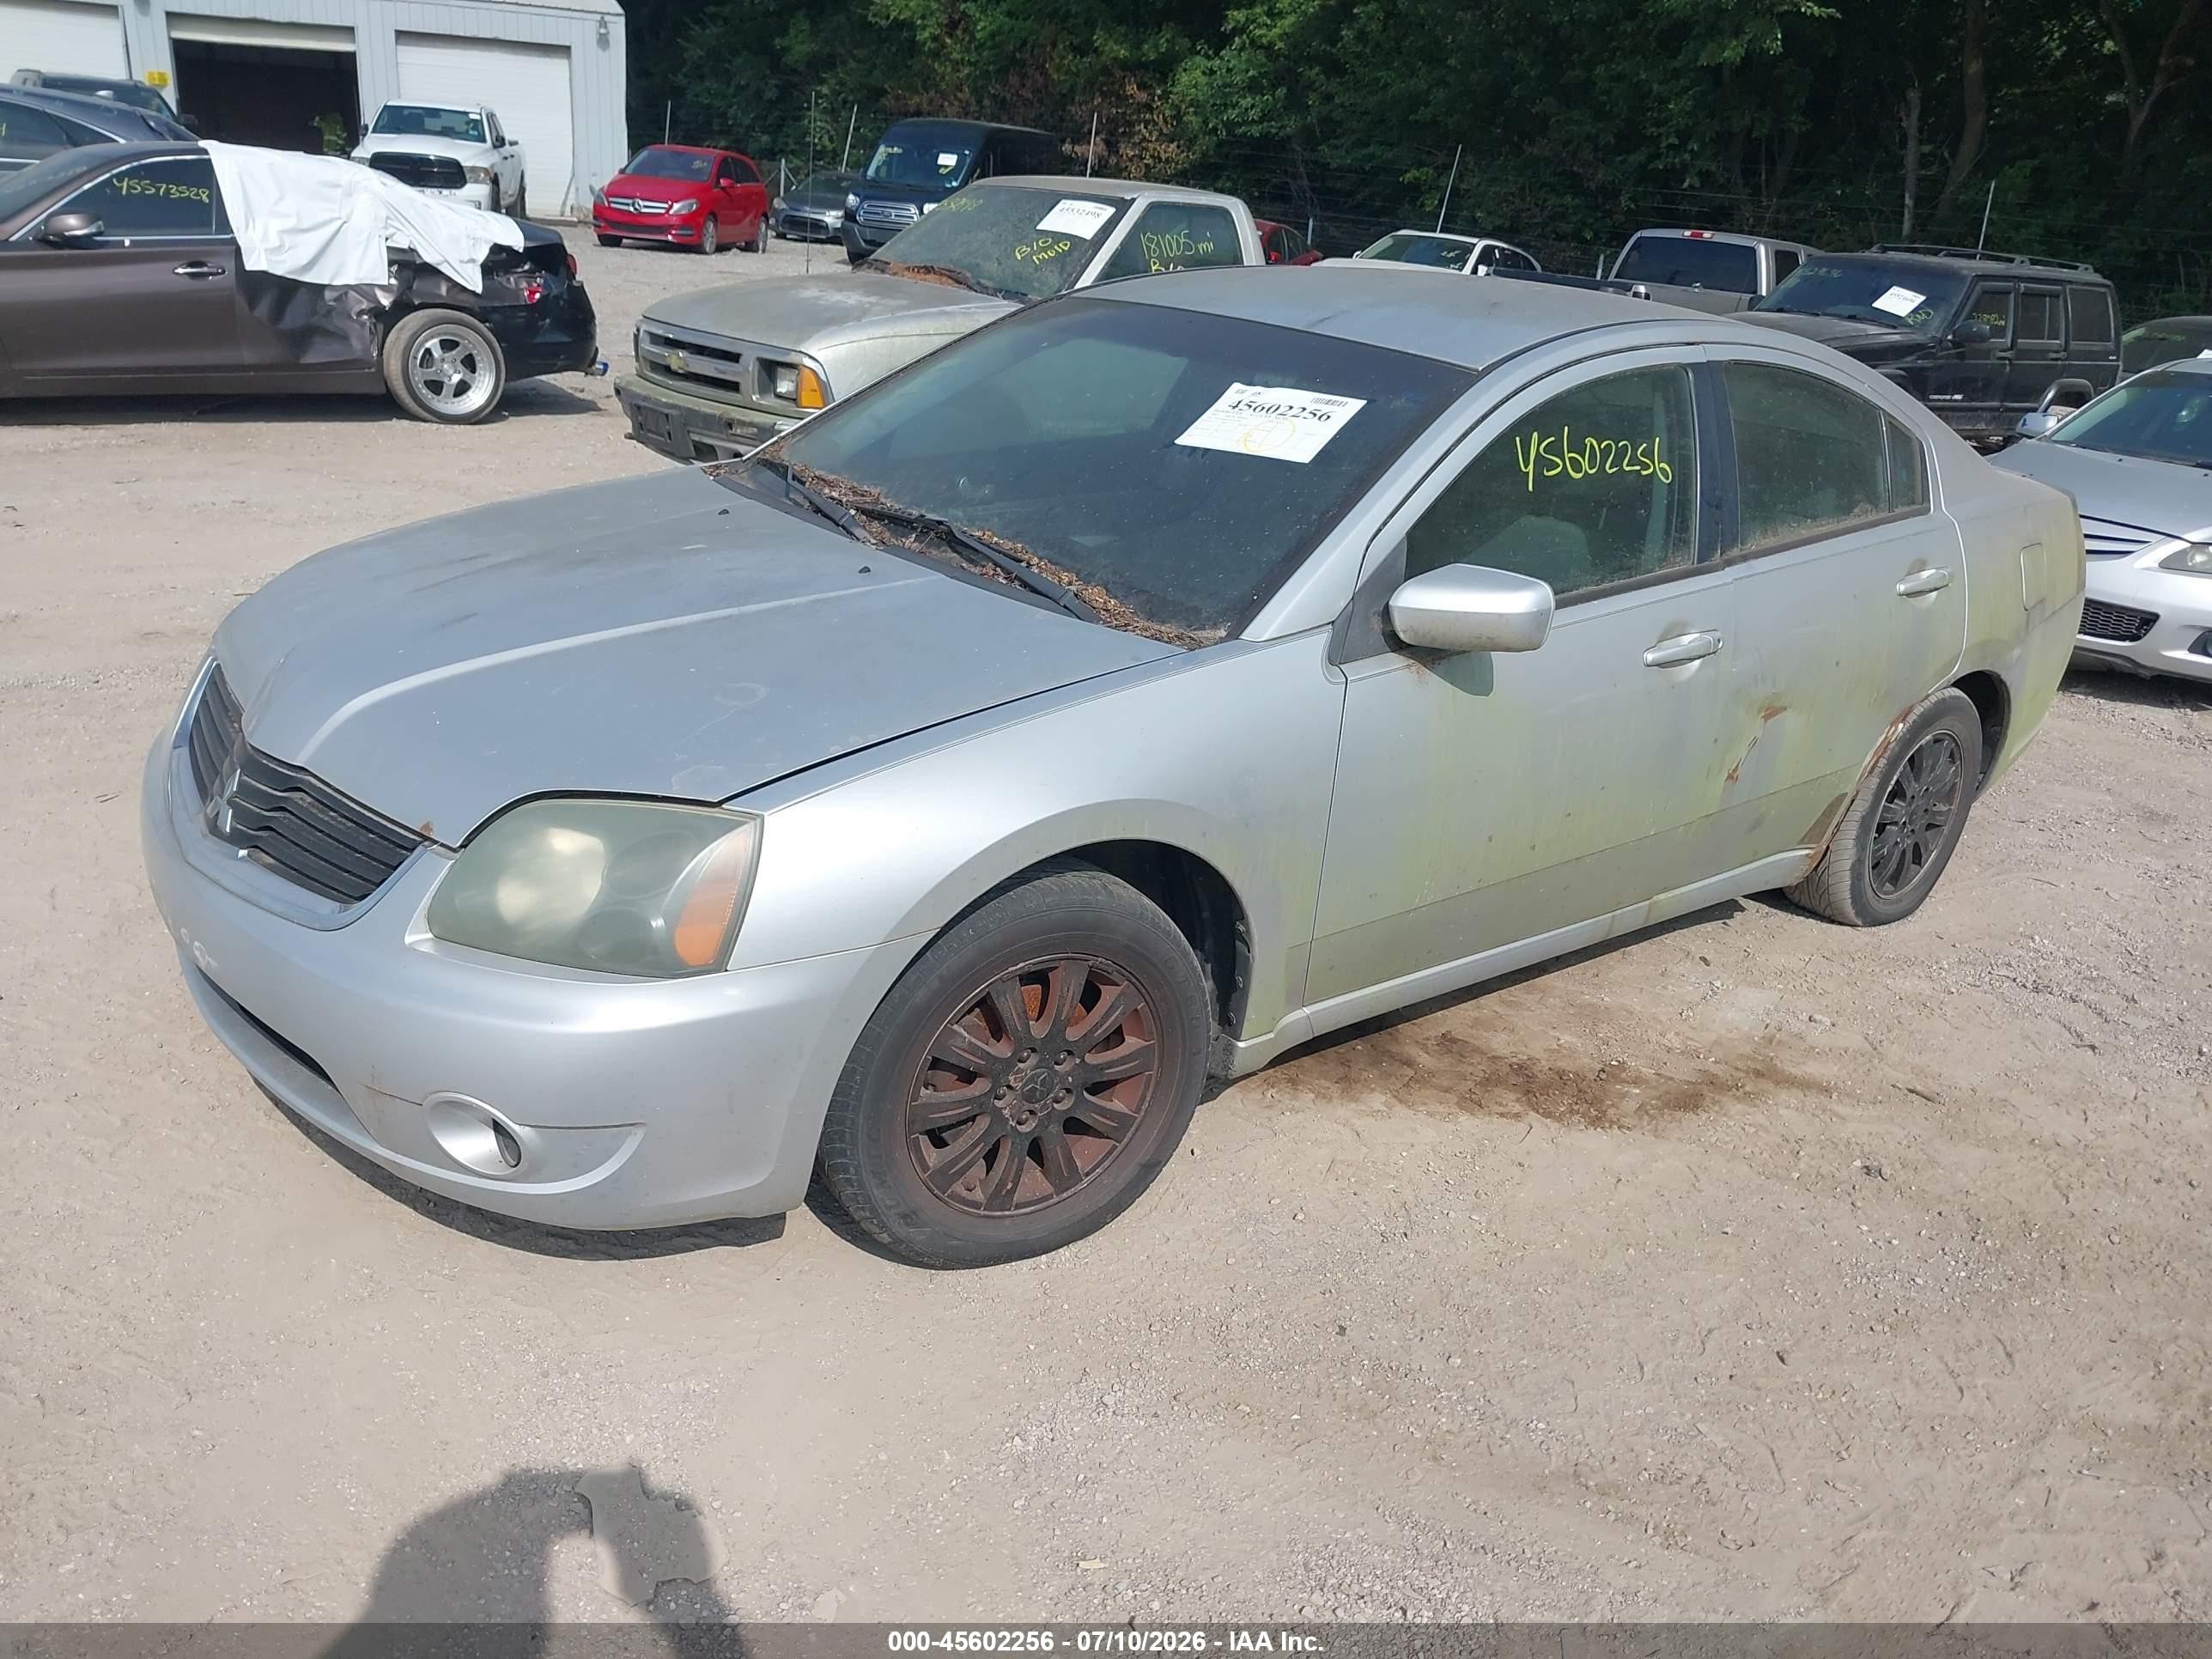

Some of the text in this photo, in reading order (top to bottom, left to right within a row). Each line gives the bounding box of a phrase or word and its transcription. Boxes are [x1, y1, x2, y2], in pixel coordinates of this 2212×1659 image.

[112, 177, 210, 204] 45573528
[1140, 230, 1214, 259] 181005 mi
[1228, 398, 1337, 422] 45602256
[1515, 426, 1673, 492] 45602256
